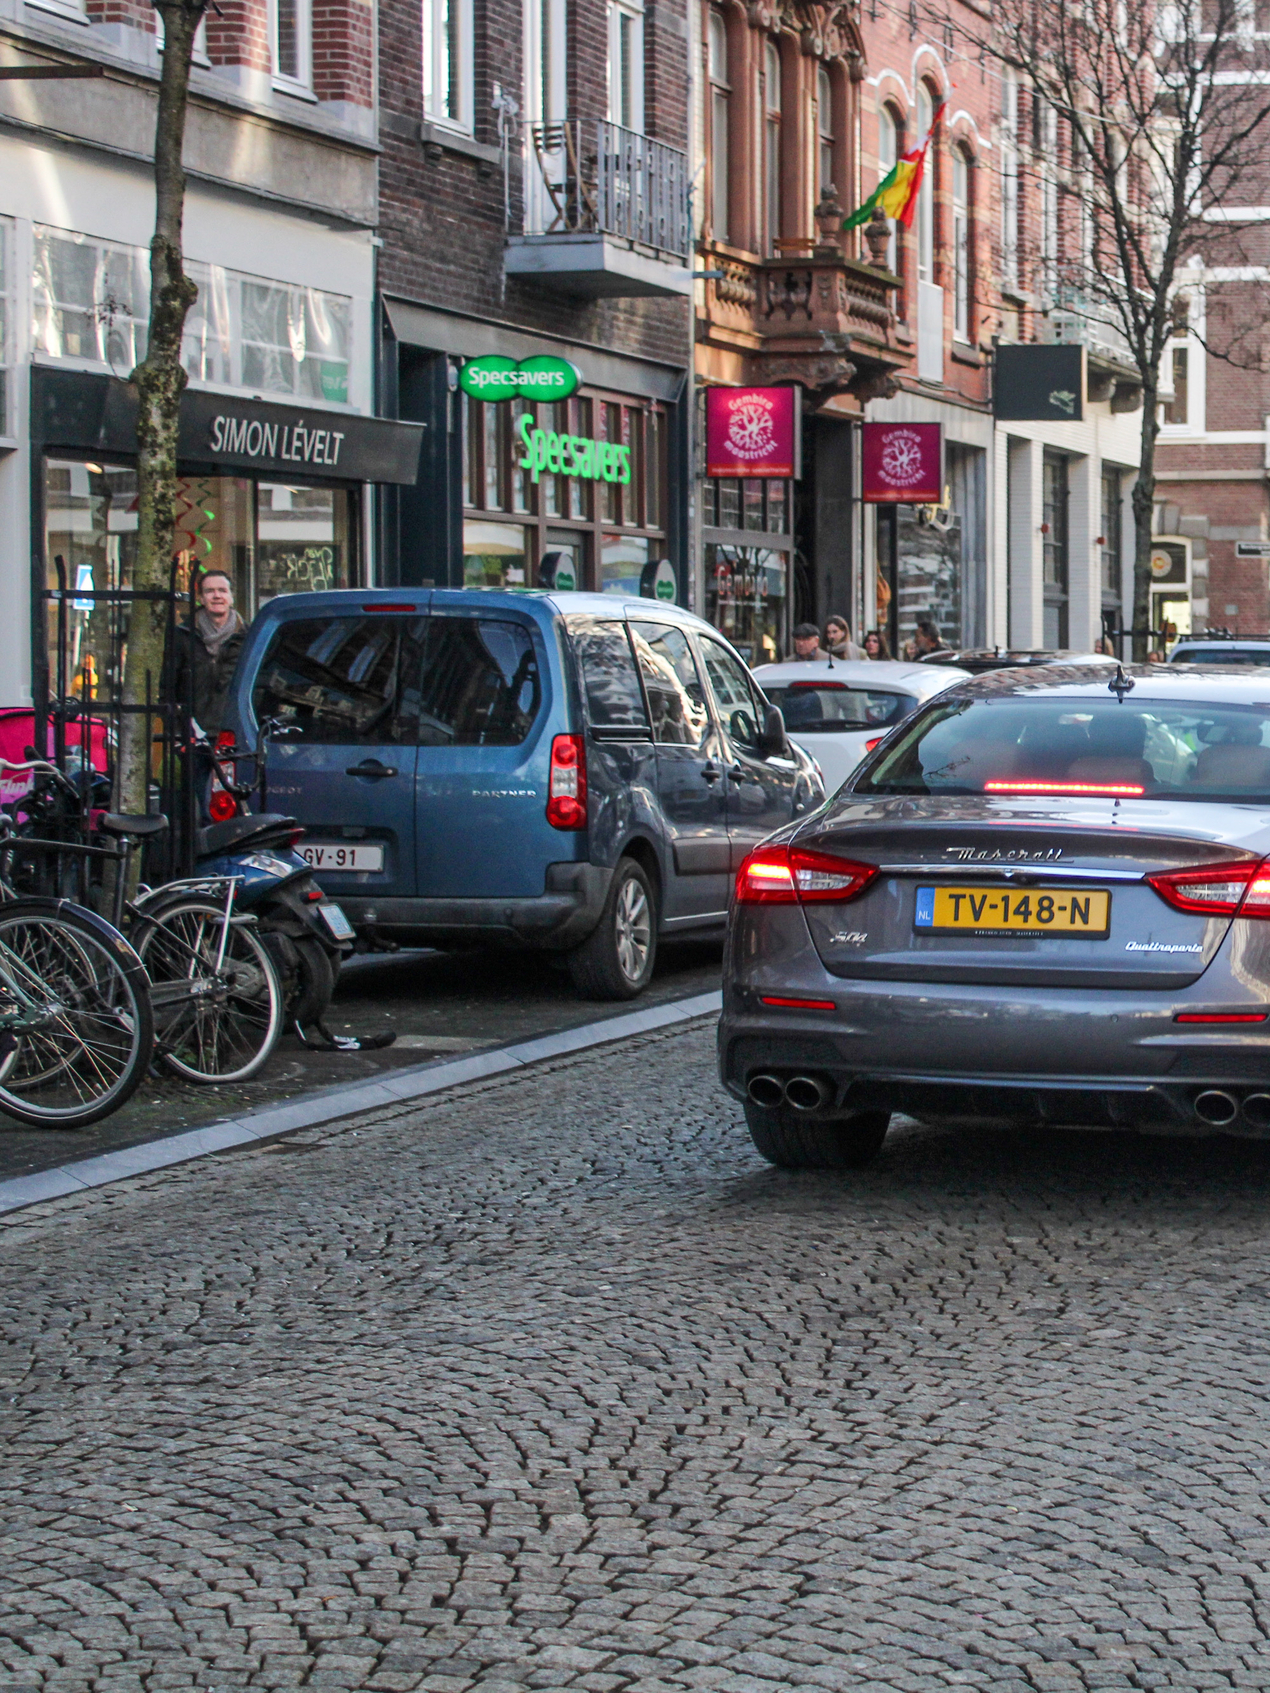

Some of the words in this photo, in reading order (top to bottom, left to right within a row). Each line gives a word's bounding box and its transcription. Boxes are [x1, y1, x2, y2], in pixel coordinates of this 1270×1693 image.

[468, 367, 565, 388] Specsavers
[210, 416, 279, 457] SIMON
[281, 419, 345, 465] LÉVELT
[518, 413, 631, 484] Specsavers
[724, 440, 778, 460] maastricht
[472, 789, 537, 799] PARTNER
[946, 847, 1075, 864] Maserati
[918, 910, 931, 921] NL
[948, 894, 1091, 926] TV-148-N
[1125, 941, 1203, 954] Quattroporte
